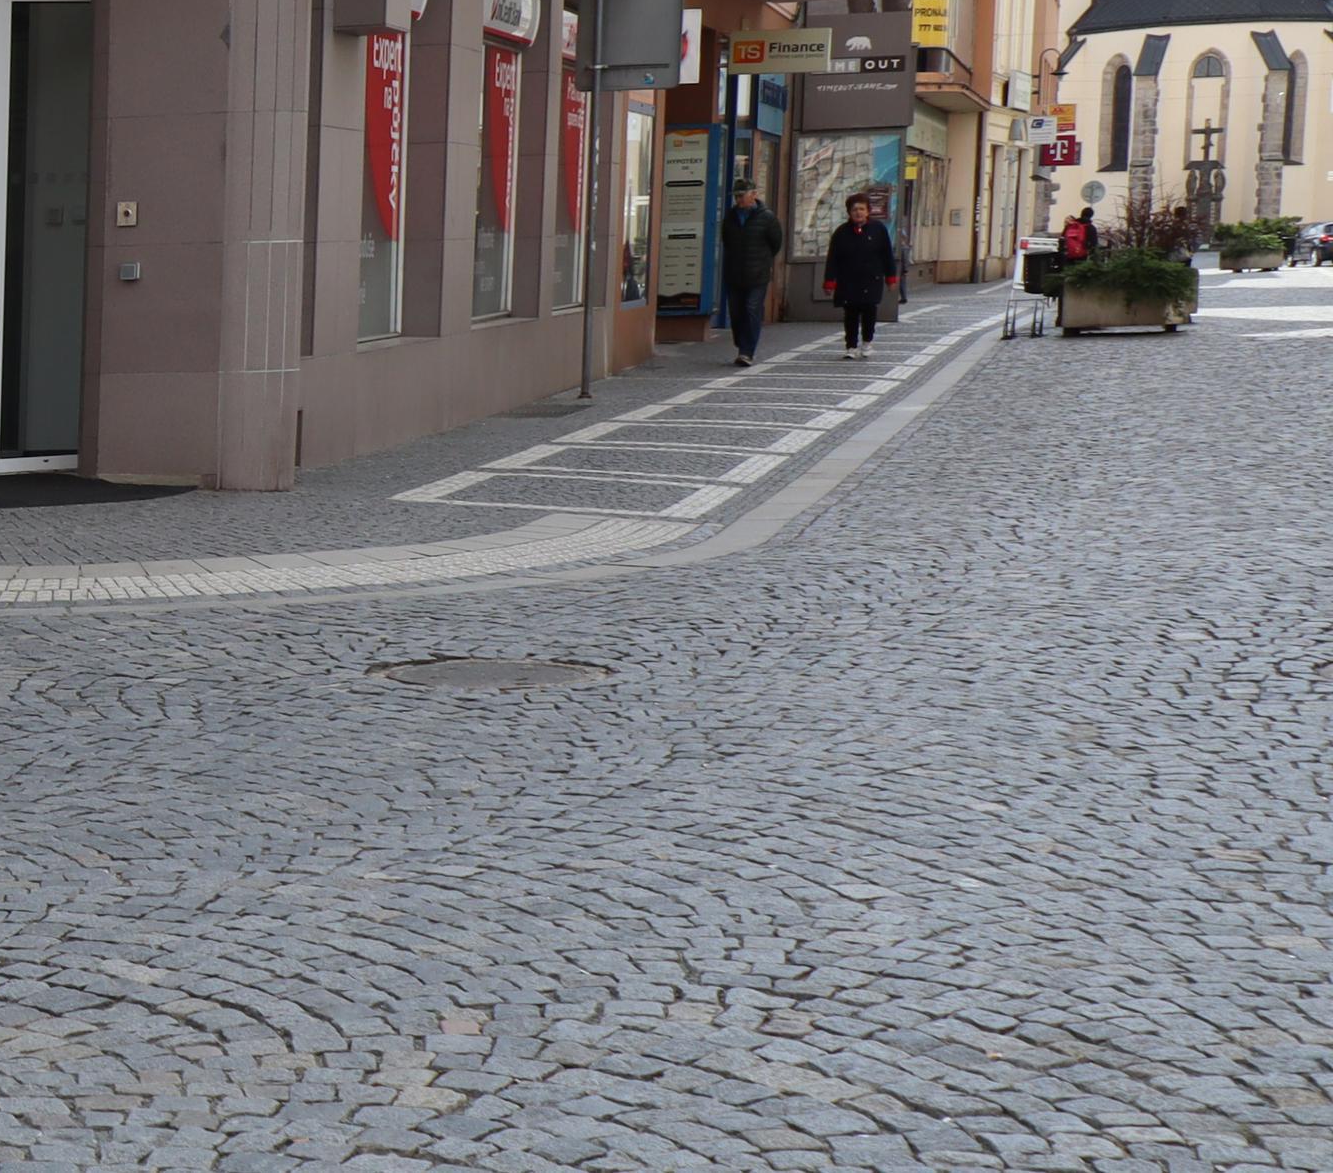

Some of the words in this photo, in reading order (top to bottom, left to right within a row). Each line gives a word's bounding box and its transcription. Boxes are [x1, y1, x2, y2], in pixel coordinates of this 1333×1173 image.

[374, 33, 402, 79] Expert
[737, 44, 761, 60] TS
[769, 42, 825, 53] Finance
[864, 59, 901, 69] OUT
